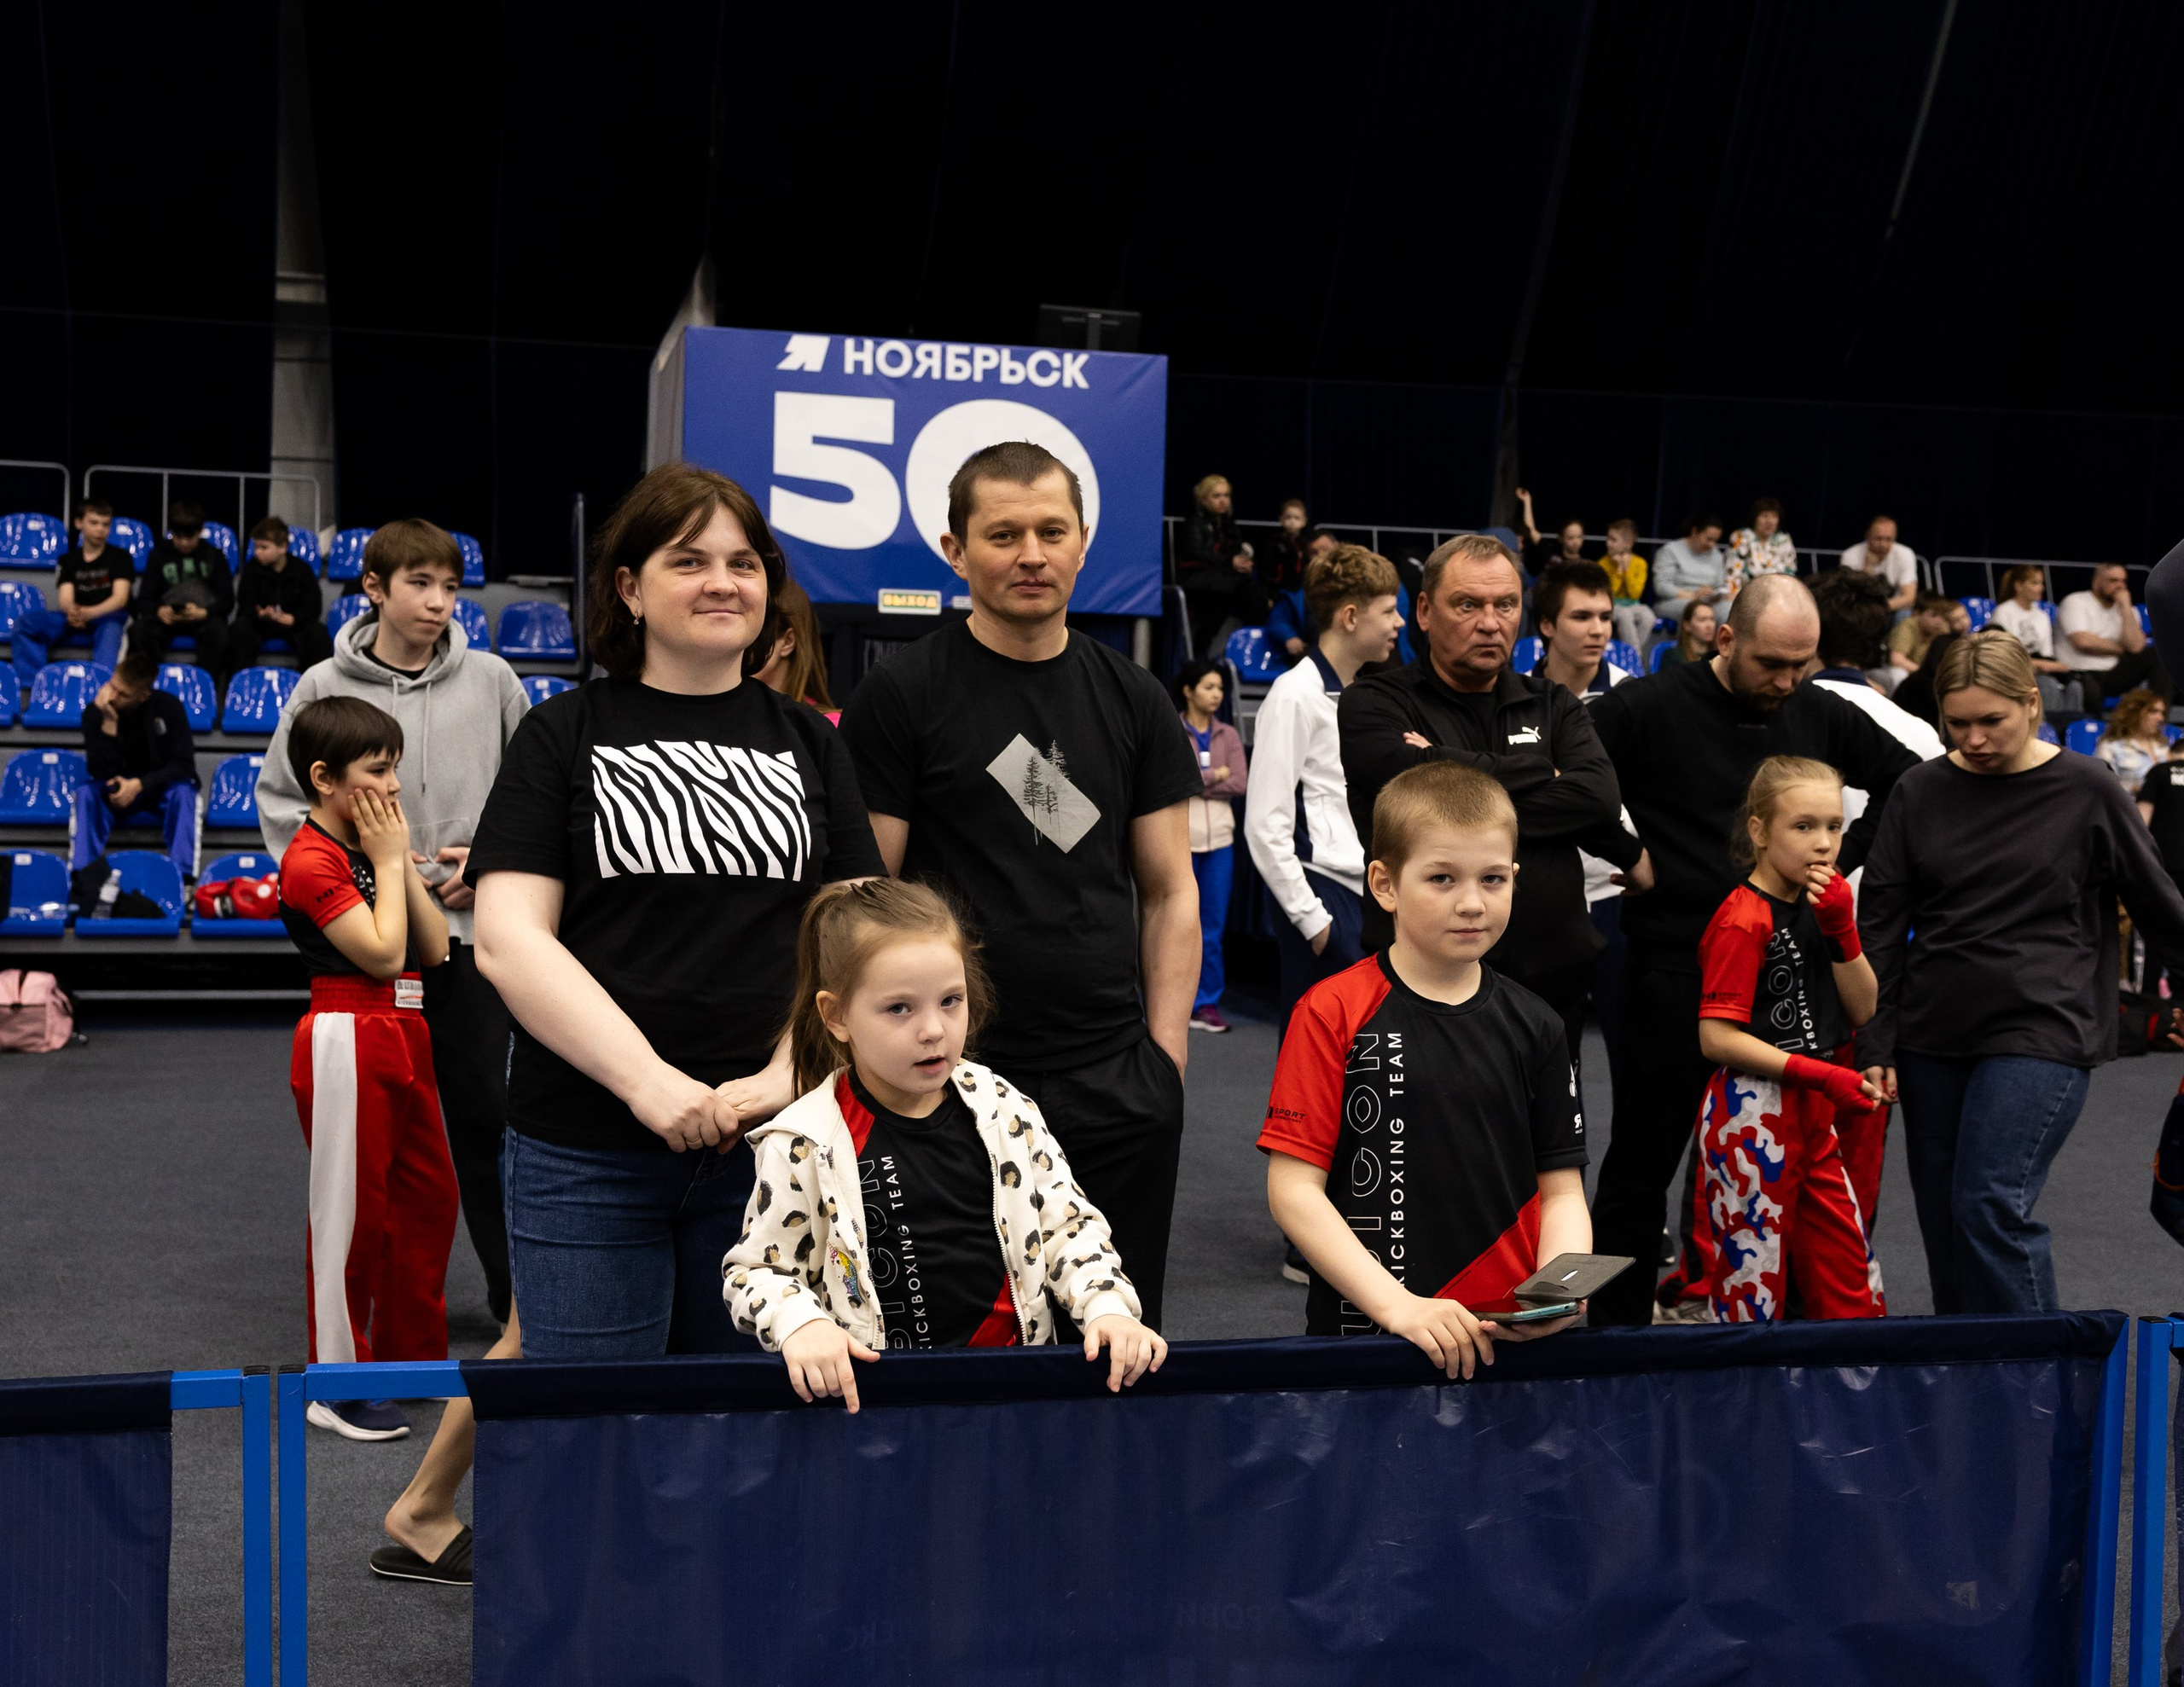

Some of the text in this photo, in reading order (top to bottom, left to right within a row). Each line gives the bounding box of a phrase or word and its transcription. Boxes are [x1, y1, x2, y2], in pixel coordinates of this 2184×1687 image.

[844, 338, 1091, 390] НОЯБРЬСК
[882, 593, 938, 610] ВЫХОД
[1780, 927, 1804, 967] TEAM
[1387, 1033, 1403, 1097] TEAM
[1275, 1107, 1305, 1119] SPORT
[880, 1156, 932, 1349] ICKBOXING TEAM
